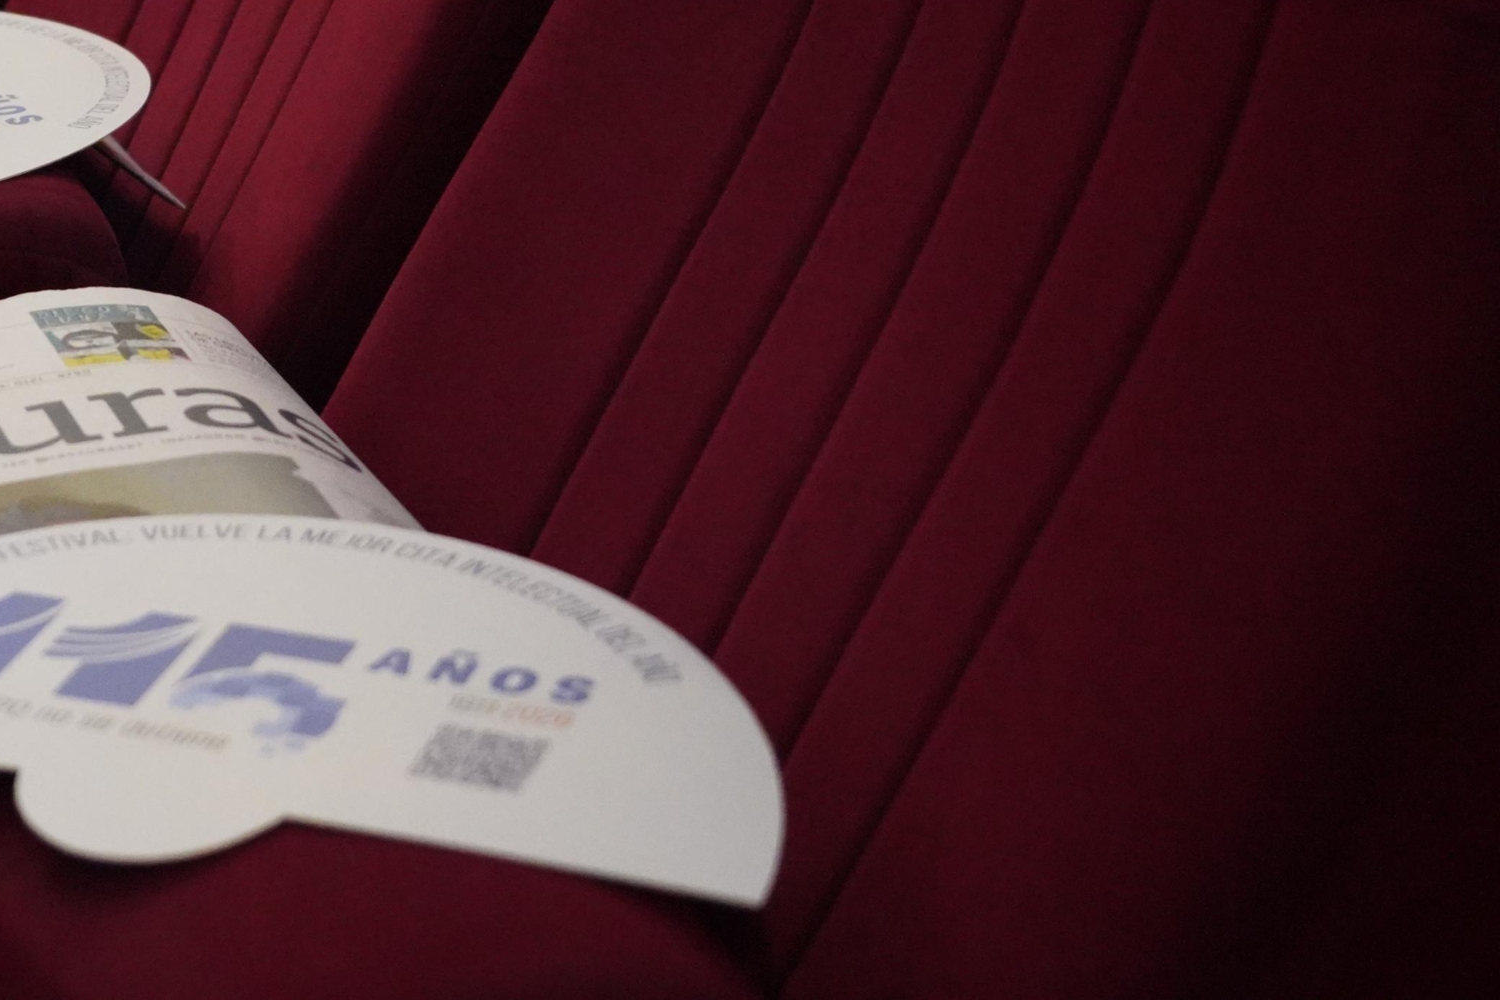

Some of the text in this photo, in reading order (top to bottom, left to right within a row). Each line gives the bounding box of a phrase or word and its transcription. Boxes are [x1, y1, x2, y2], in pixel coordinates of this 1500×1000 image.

[140, 523, 251, 543] VUELVE
[257, 524, 293, 543] LA
[300, 527, 395, 554] MEJOR
[395, 539, 457, 568] CITA
[367, 647, 595, 706] AÑOS
